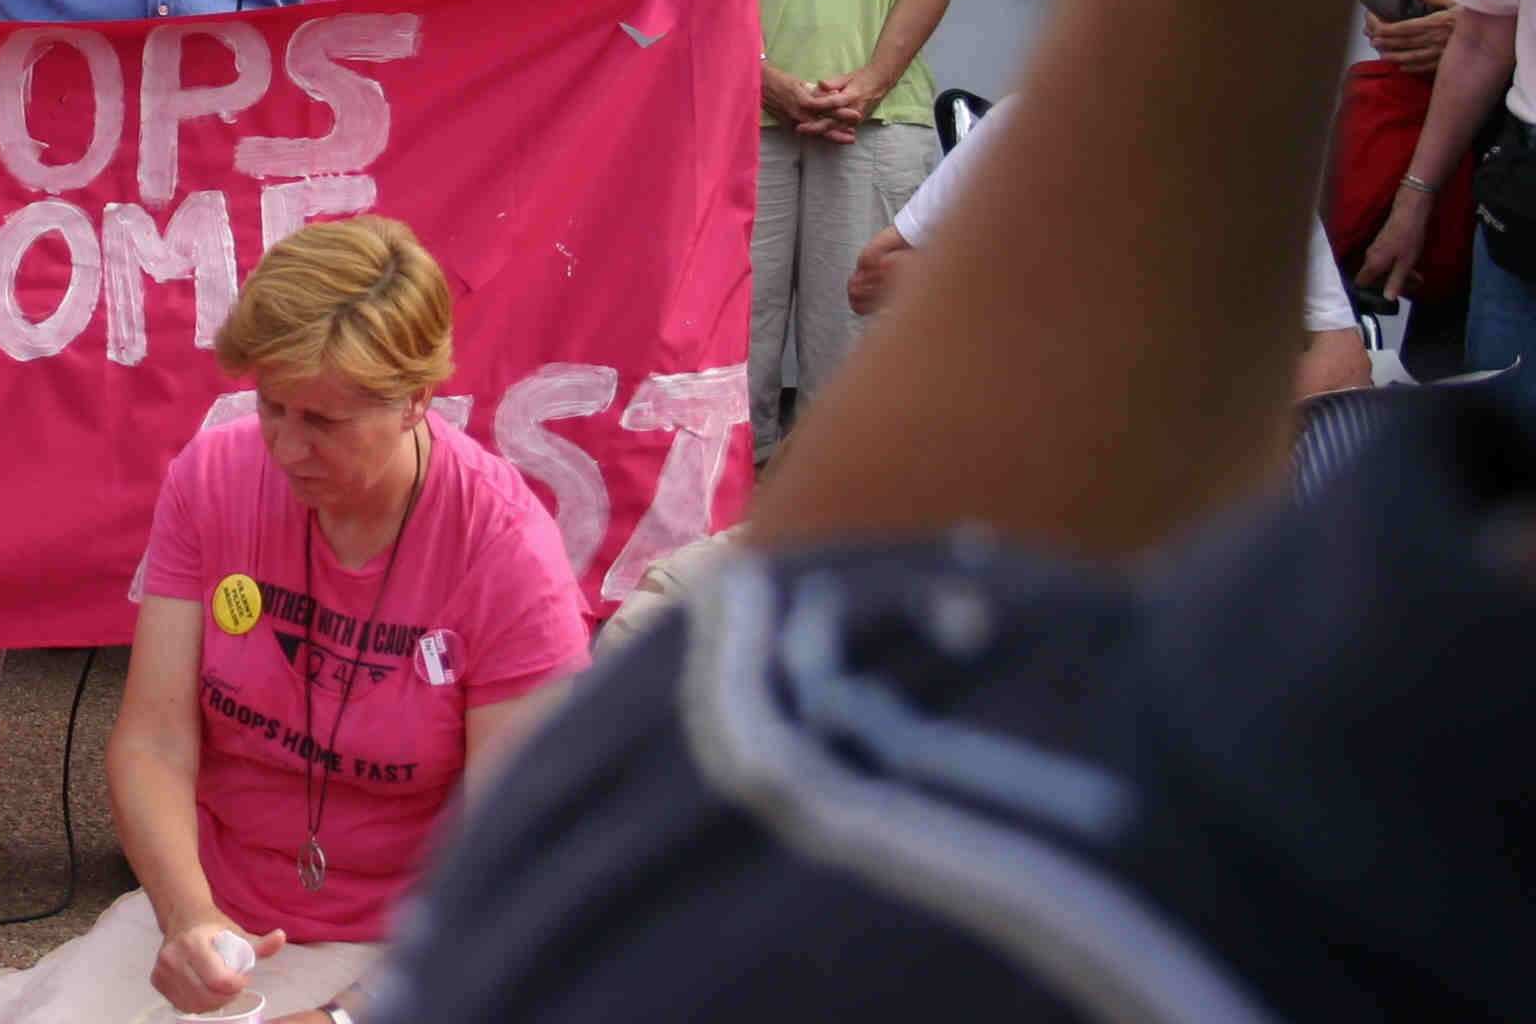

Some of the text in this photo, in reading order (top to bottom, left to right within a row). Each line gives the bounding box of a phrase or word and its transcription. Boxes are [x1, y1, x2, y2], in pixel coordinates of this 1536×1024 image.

[260, 581, 317, 626] OTHER
[318, 605, 357, 647] WITH
[199, 677, 281, 740] TROOPS
[282, 727, 343, 773] HOME
[354, 759, 419, 784] FAST
